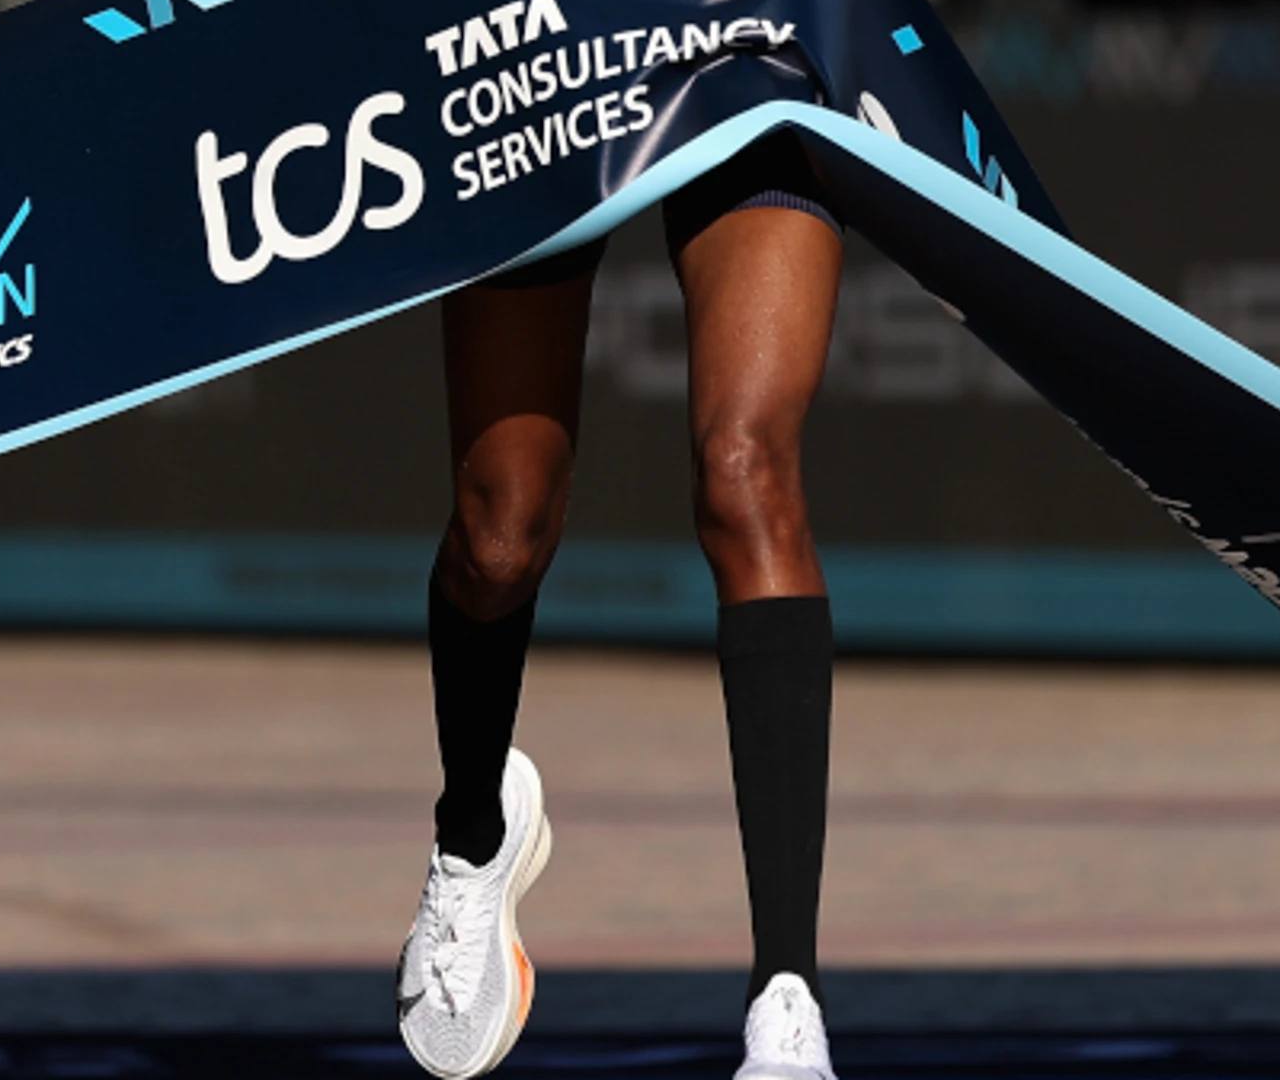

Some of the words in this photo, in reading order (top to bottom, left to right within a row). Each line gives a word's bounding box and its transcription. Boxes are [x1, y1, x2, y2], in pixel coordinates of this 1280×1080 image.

[440, 17, 797, 137] CONSULTANCY
[195, 90, 424, 286] tcs
[452, 84, 654, 201] SERVICES
